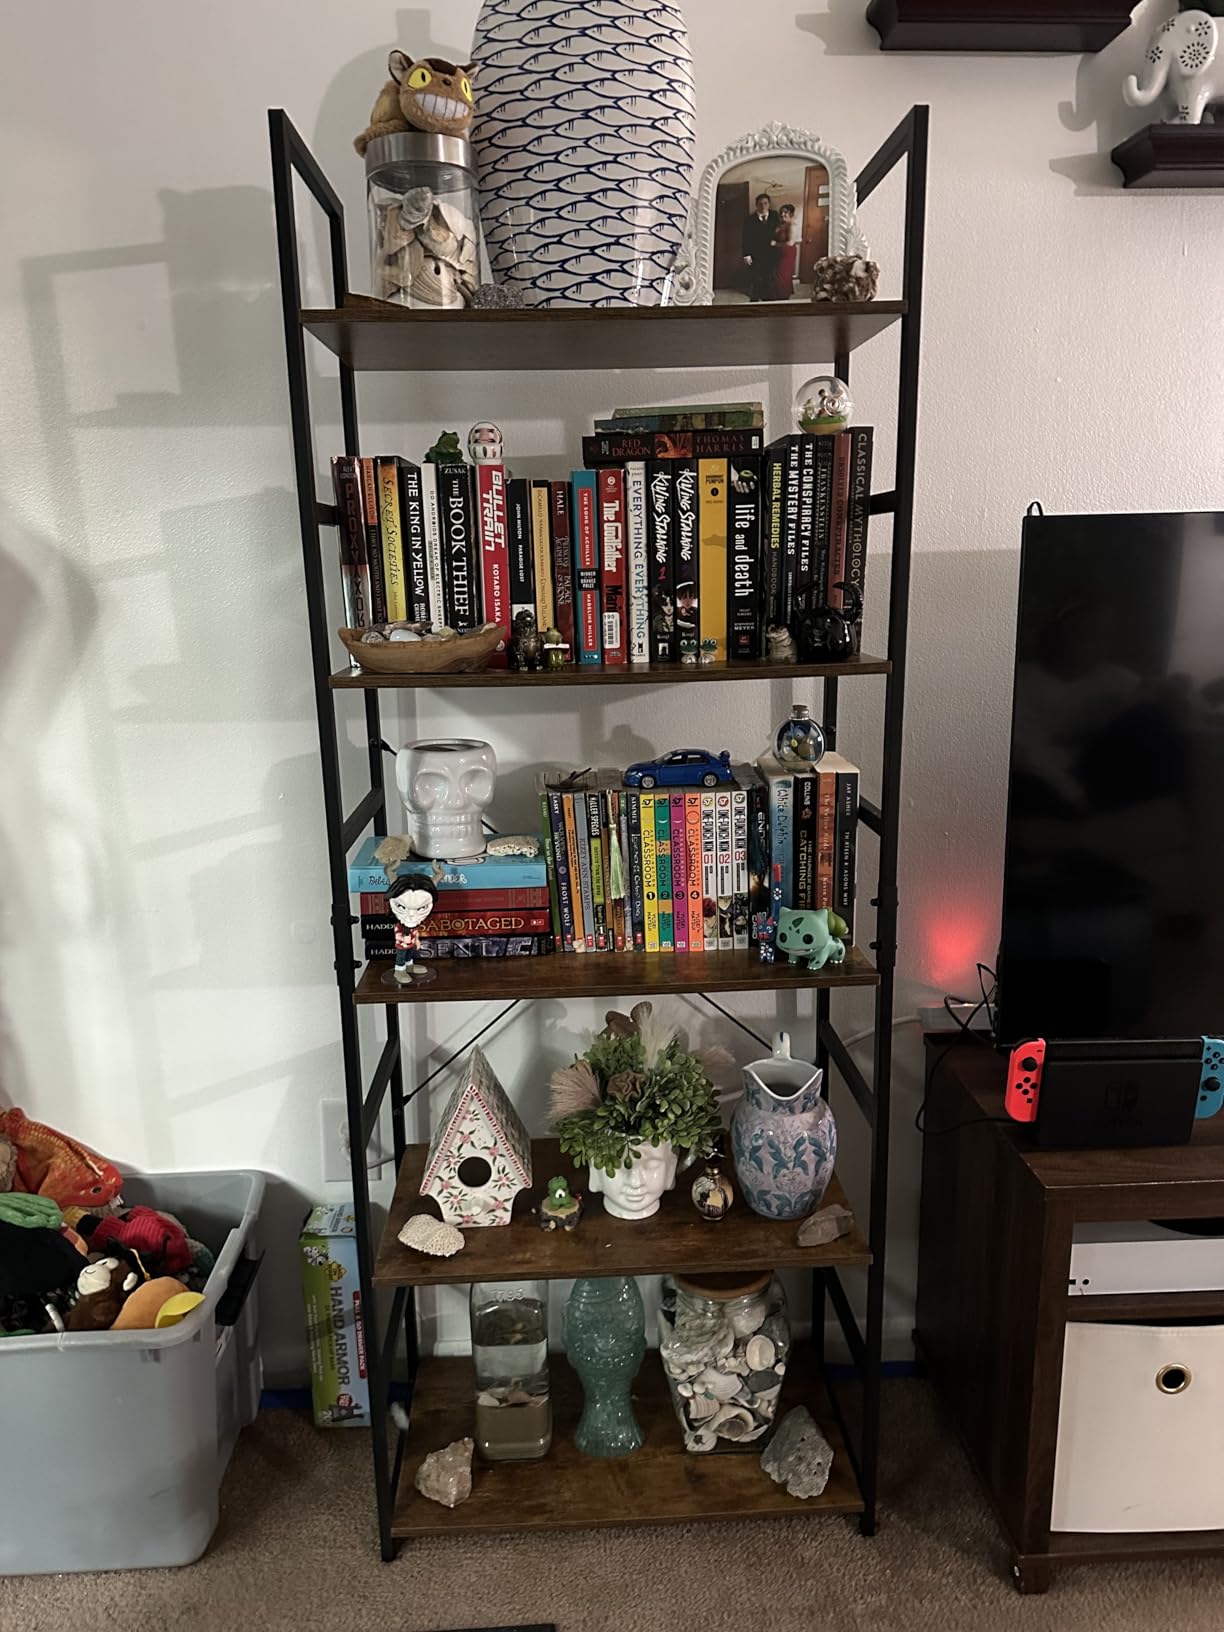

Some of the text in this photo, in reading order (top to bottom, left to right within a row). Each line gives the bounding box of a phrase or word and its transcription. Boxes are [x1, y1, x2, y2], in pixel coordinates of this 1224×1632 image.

[612, 446, 650, 457] DRAGON
[621, 439, 640, 448] RED
[696, 433, 744, 444] THOMAS
[696, 443, 744, 454] HARRIS
[451, 479, 460, 496] THE
[771, 462, 782, 501] HERBAL
[367, 493, 375, 520] ELLISON
[382, 478, 398, 528] SECRET
[491, 470, 505, 549] BULLET
[555, 490, 564, 516] HALE
[603, 500, 620, 521] The
[786, 445, 800, 556] THE MYSTERY FILES
[800, 443, 814, 572] THE CONSPIRACY FILES
[817, 467, 828, 540] FRANKENSTEIN
[849, 432, 868, 587] CLASSICAL MYTHOLOGY
[429, 490, 435, 500] DO
[435, 563, 440, 571] OF
[449, 496, 466, 554] BOOK
[482, 489, 496, 552] TRAIN
[584, 526, 590, 535] OF
[734, 503, 756, 529] life
[770, 501, 780, 550] REMEDIES
[407, 472, 425, 597] THE KING IN YELLOW
[603, 522, 623, 572] Godfather
[734, 533, 749, 551] and
[386, 528, 400, 586] SOCIETIES
[561, 536, 569, 567] PRINCESS
[452, 556, 470, 616] THIEF
[734, 554, 755, 597] death
[769, 551, 778, 595] HANDBOOK
[492, 563, 502, 623] KOTARO ISAKA
[557, 583, 565, 606] STONE
[563, 575, 572, 604] PALACE
[603, 584, 623, 613] Mari
[634, 563, 646, 639] EVERYTHING
[552, 796, 560, 814] LASKY
[776, 788, 790, 813] White
[802, 781, 812, 806] COLLINS
[822, 794, 831, 806] The
[630, 796, 638, 825] KIMMEL
[702, 809, 714, 841] ONE-PUNCH
[717, 809, 730, 841] ONE-PUNCH
[734, 806, 746, 838] ONE-PUNCH
[591, 815, 601, 836] SPECIES
[777, 815, 789, 846] Dolphin
[553, 832, 563, 861] BEYOND
[579, 838, 587, 860] KIZZY
[656, 828, 668, 887] CLASSROOM
[672, 828, 682, 887] CLASSROOM
[688, 828, 698, 887] CLASSROOM
[703, 841, 715, 852] MAN
[718, 841, 730, 853] MAN
[734, 850, 747, 861] 03
[735, 837, 746, 849] MAN
[642, 829, 655, 888] CLASSROOM
[703, 854, 714, 864] 01
[718, 854, 730, 864] 02
[798, 829, 809, 890] CATCHING
[806, 859, 814, 887] HUNGER
[841, 831, 851, 906] THRTEEN RASONS WHY
[582, 881, 591, 911] STAMPS
[821, 876, 829, 895] Kevin
[560, 882, 571, 927] FROST WOLF
[366, 923, 396, 931] HADD
[418, 916, 524, 932] SABOTAGED
[419, 940, 492, 959] SENT
[330, 1285, 345, 1330] HAND
[356, 1320, 363, 1330] GO
[334, 1331, 351, 1386] ARMOR
[359, 1355, 367, 1370] PACK
